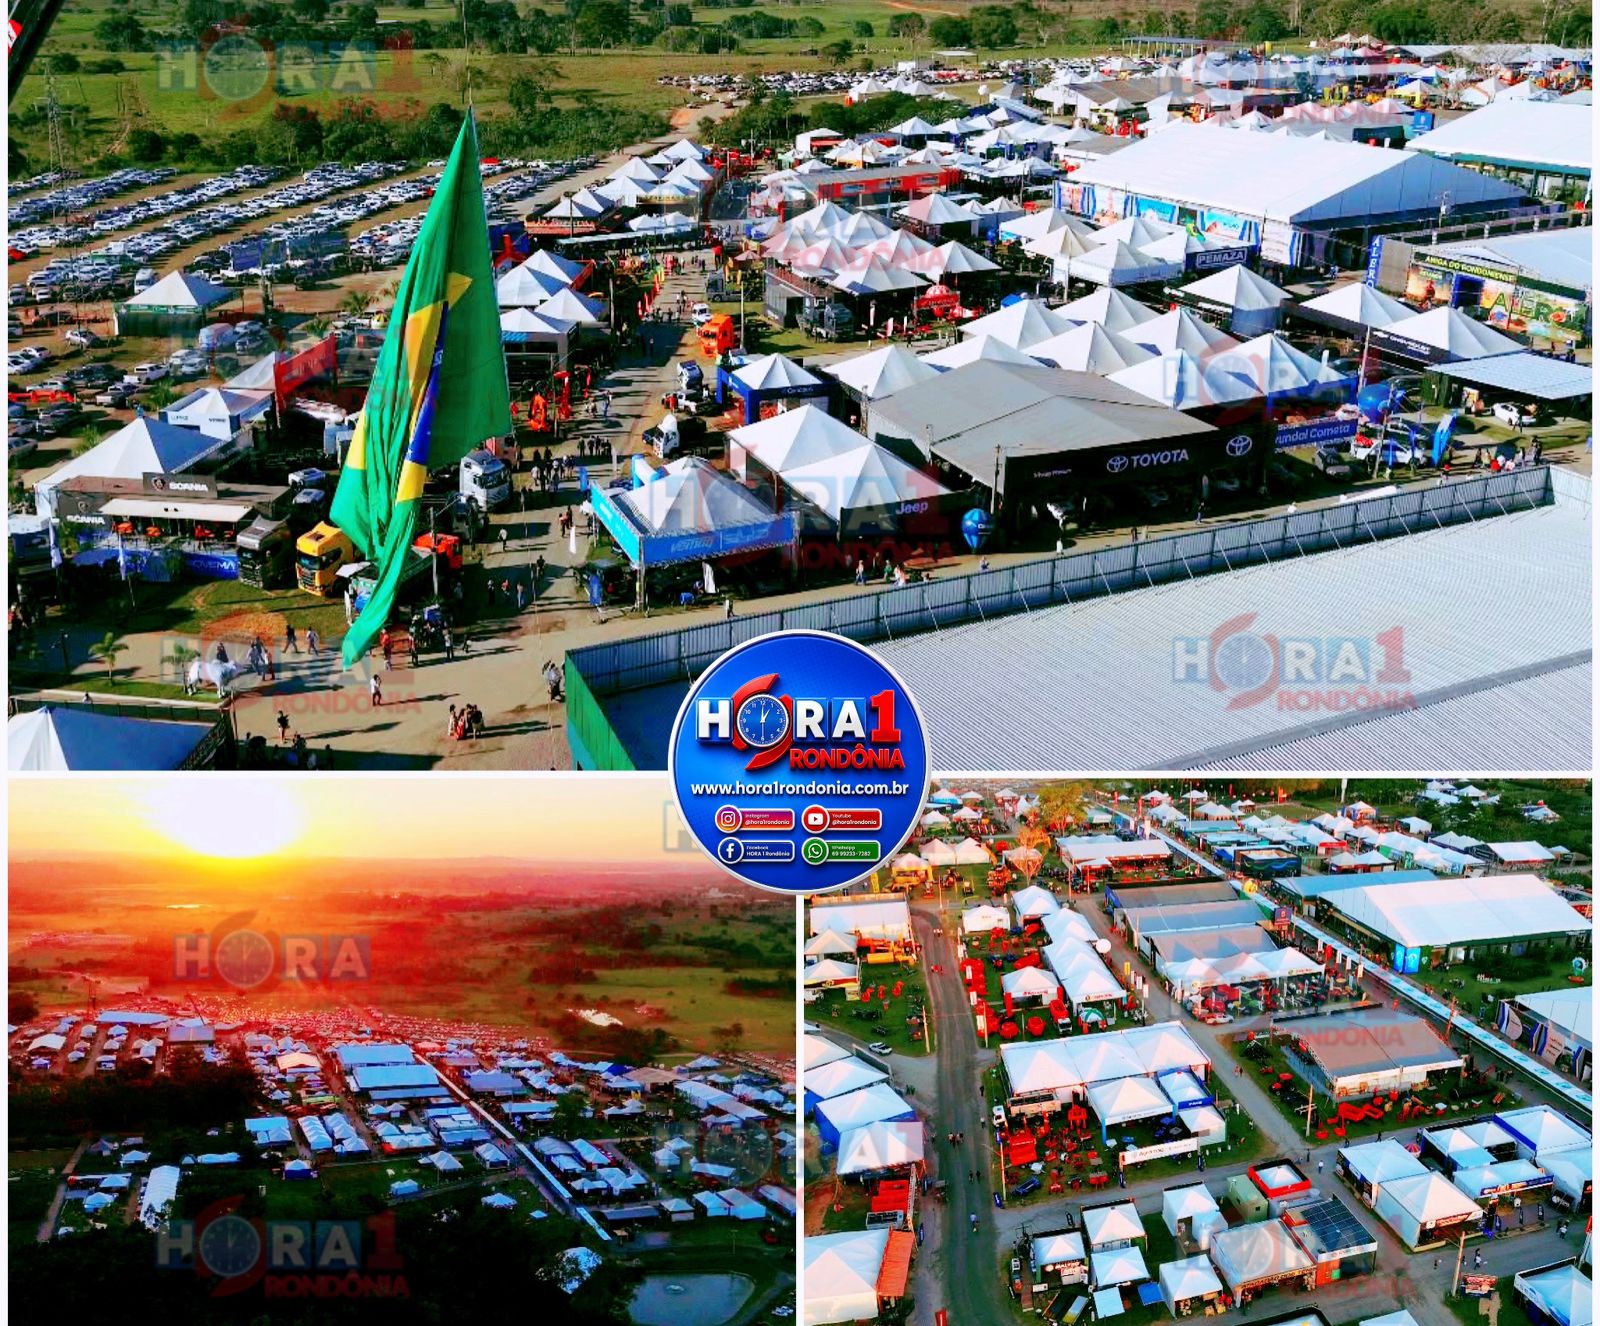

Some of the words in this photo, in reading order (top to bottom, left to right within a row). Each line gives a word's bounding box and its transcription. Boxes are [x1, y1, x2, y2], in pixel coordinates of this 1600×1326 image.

[1199, 251, 1244, 265] PEMAZA
[1425, 256, 1447, 267] AMIGA
[1449, 261, 1460, 269] DO
[1310, 425, 1350, 438] Cometa
[1131, 450, 1189, 468] TOYOTA
[169, 482, 208, 492] SCANIA
[896, 501, 928, 515] Jeep
[66, 515, 105, 525] SCANIA
